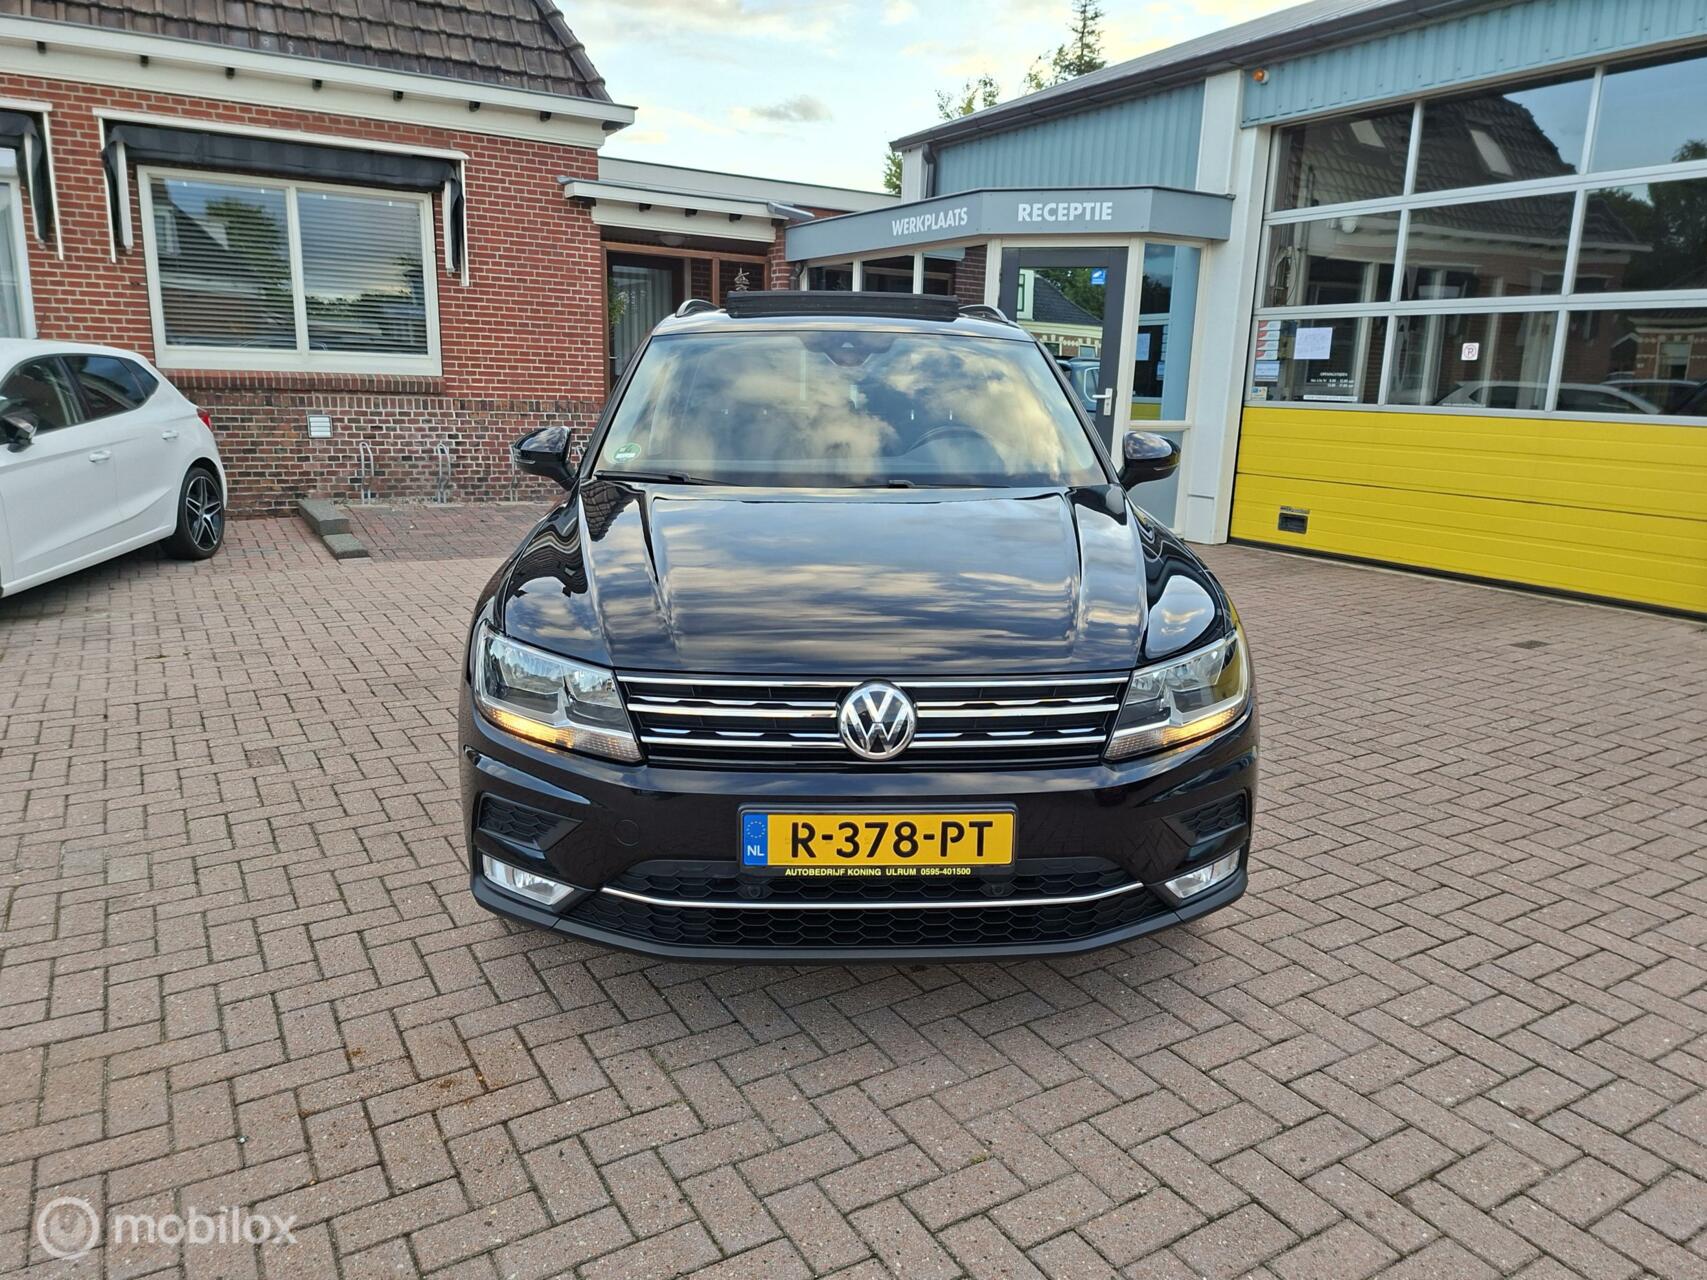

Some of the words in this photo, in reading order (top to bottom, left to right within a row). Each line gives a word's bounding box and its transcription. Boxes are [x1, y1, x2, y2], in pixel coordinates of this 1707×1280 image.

[891, 207, 968, 236] WERKPLAATS
[1017, 202, 1113, 222] RECEPTIE
[746, 846, 765, 857] NL
[790, 820, 994, 859] R-378-PT
[785, 867, 846, 877] AUTOBEDRIJF
[847, 867, 882, 876] KONING
[885, 867, 917, 876] ULRUM
[920, 867, 971, 875] 0595-401500
